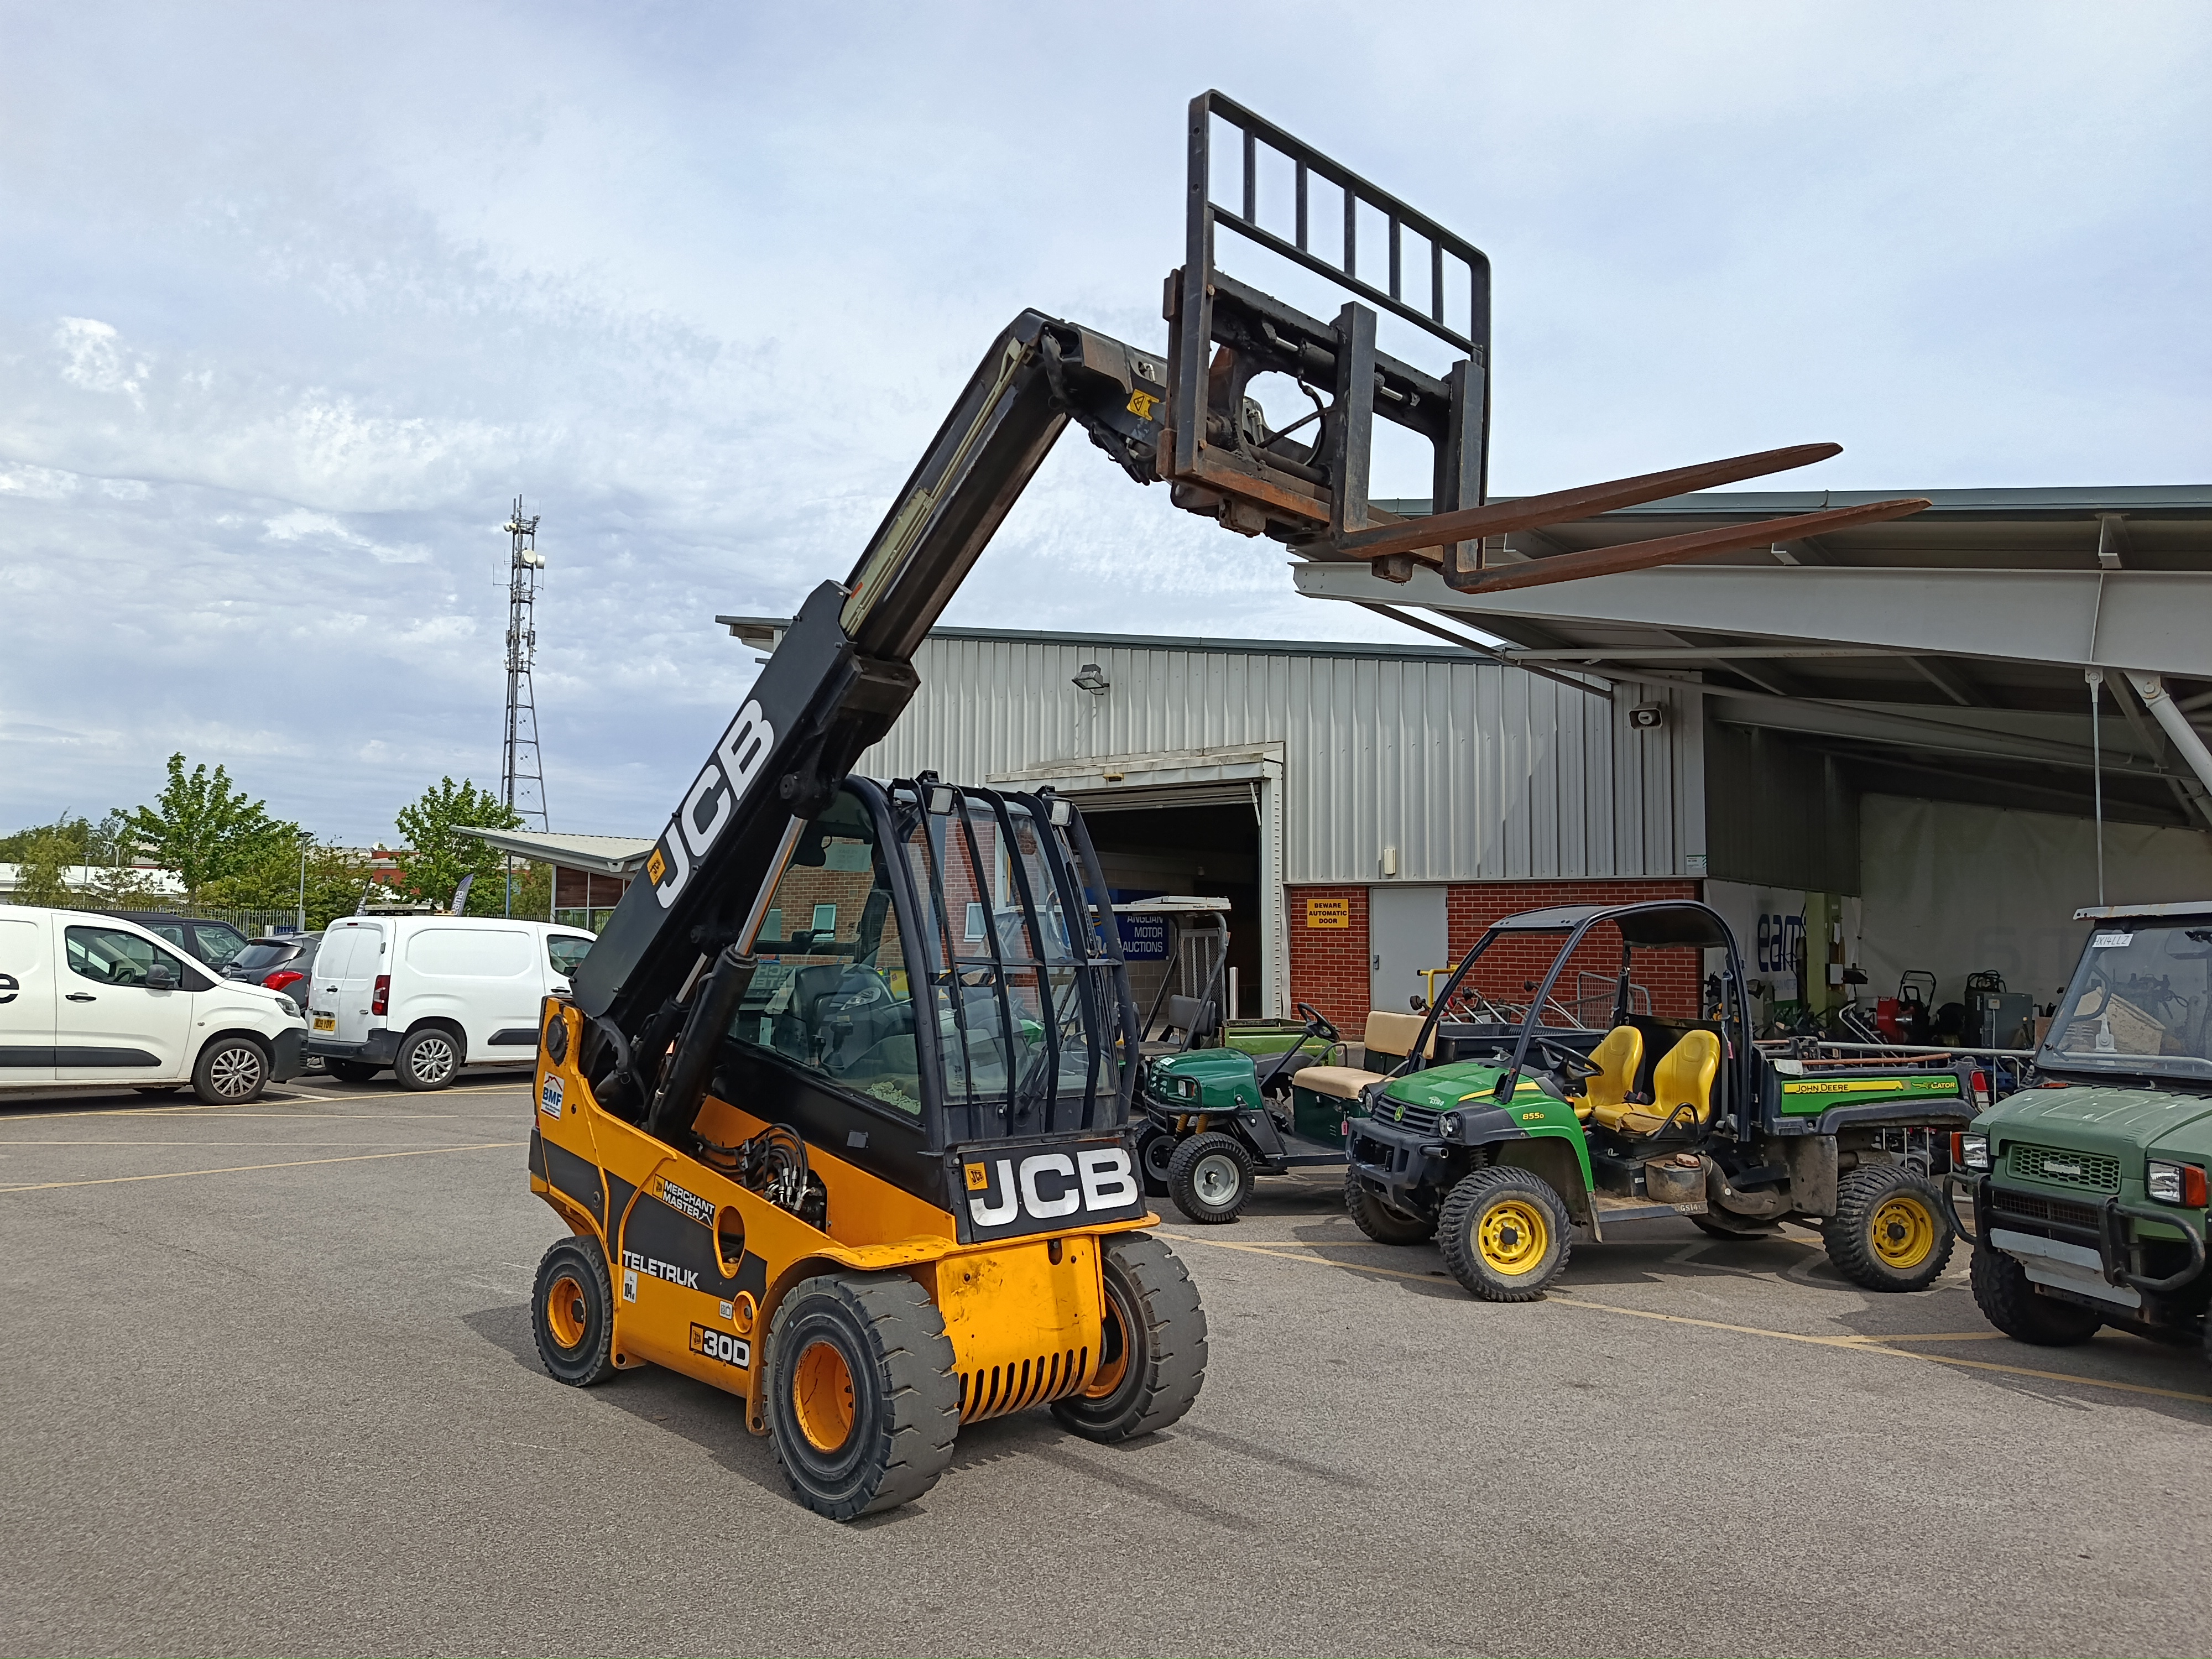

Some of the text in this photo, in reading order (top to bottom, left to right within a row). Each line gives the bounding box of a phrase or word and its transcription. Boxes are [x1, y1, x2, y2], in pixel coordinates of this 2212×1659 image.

[656, 700, 775, 909] JCB
[1122, 941, 1163, 952] AUCTIONS
[1134, 927, 1163, 938] MOTOR
[1757, 914, 1806, 973] eam
[542, 1087, 562, 1106] BMF
[1796, 1084, 1820, 1093] JOHN
[969, 1147, 1138, 1227] JCB
[971, 1170, 984, 1183] JCB
[662, 1191, 700, 1219] MASTER
[664, 1180, 715, 1214] MERCHANT
[623, 1250, 699, 1290] TELETRUK
[703, 1330, 750, 1367] 30D
